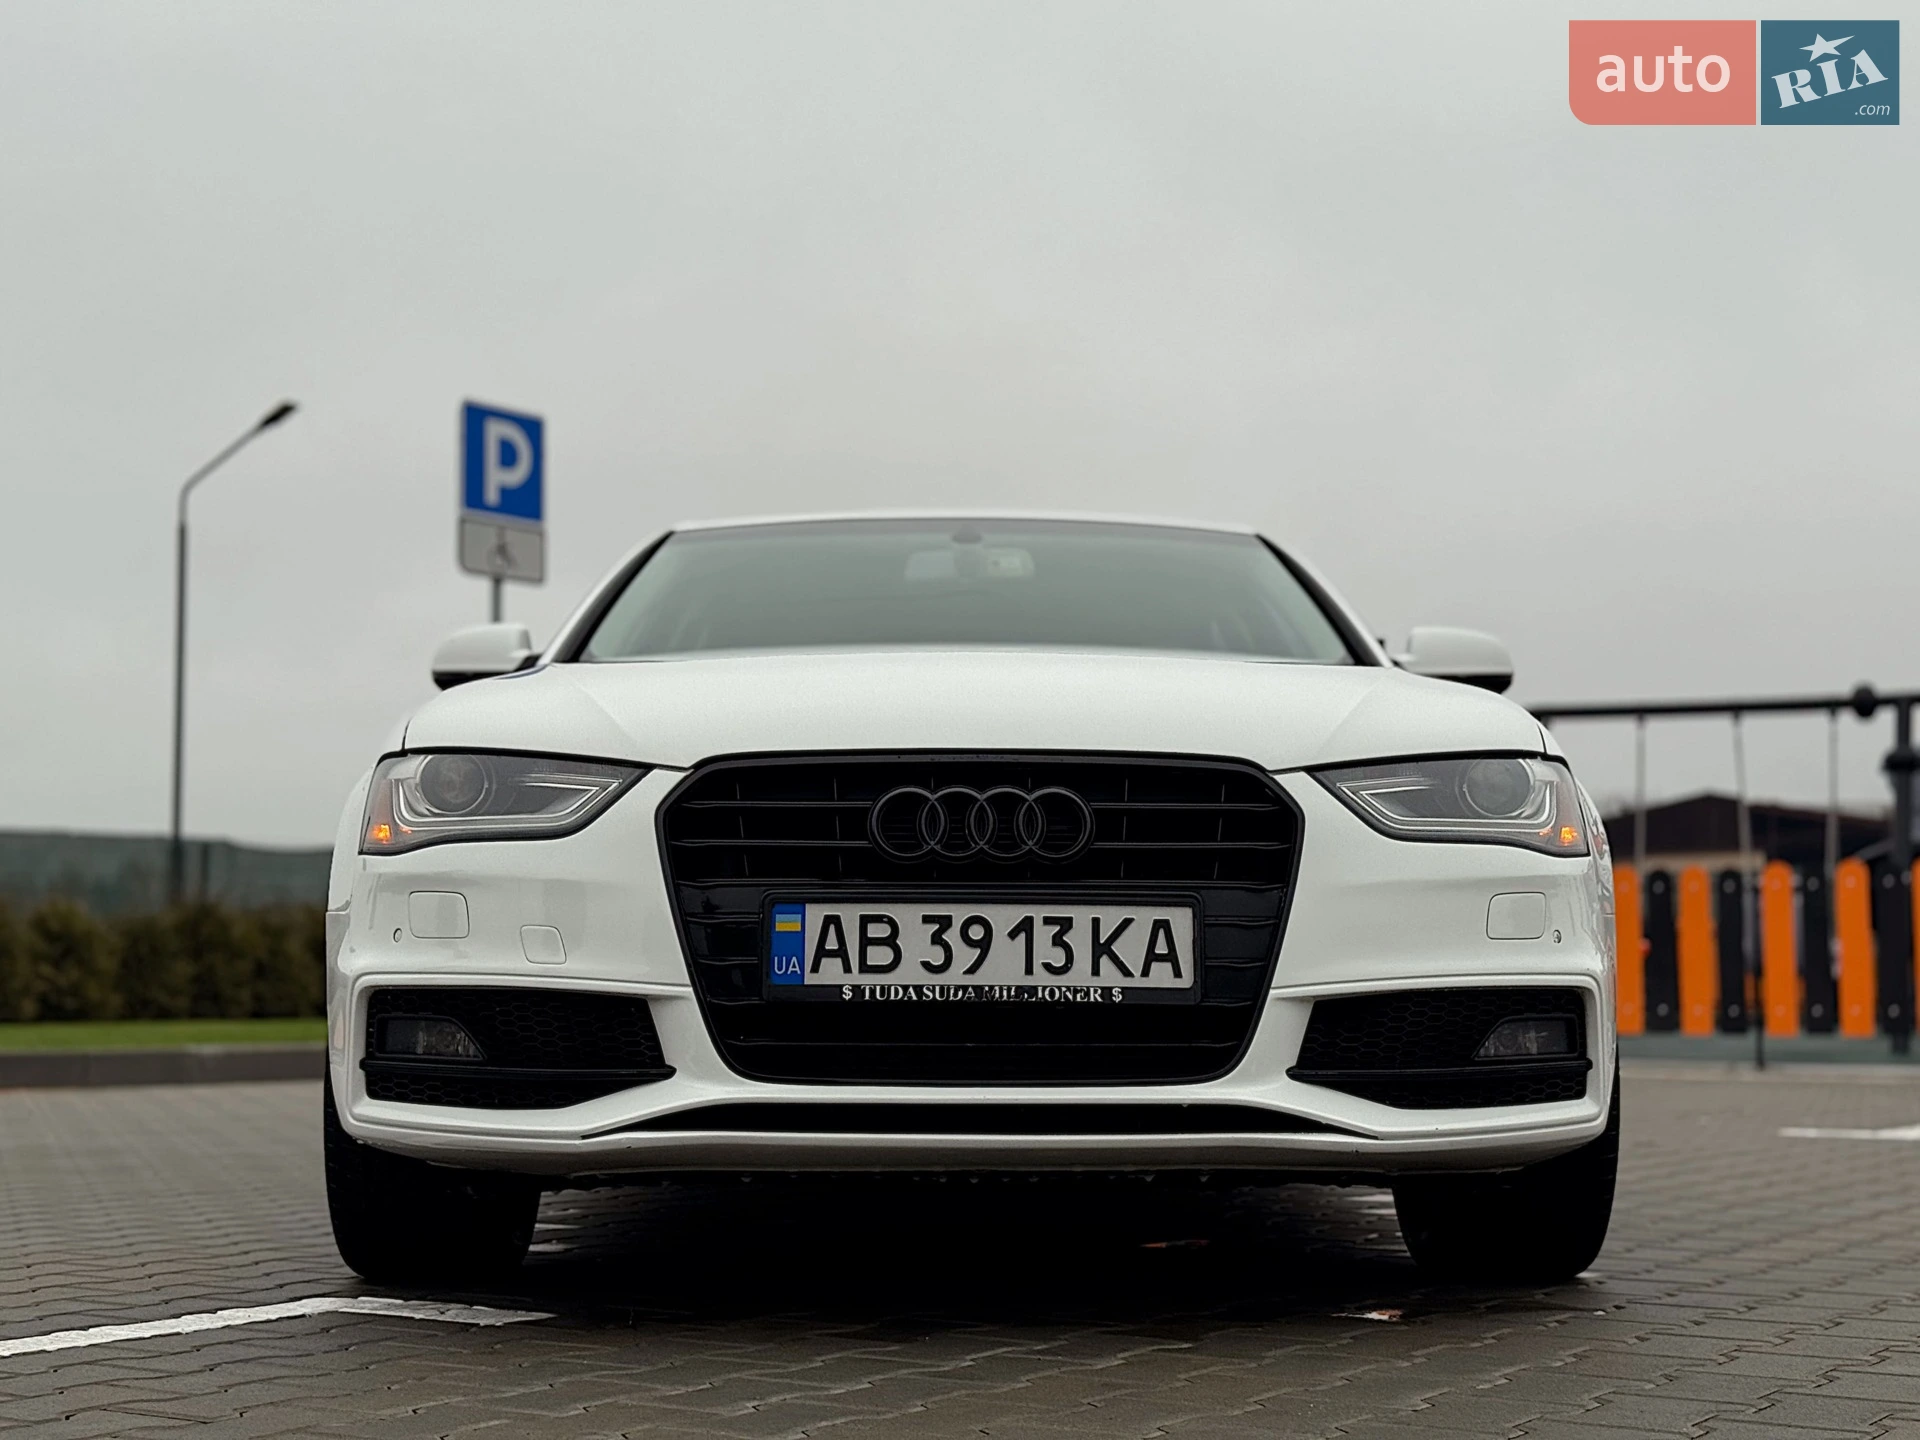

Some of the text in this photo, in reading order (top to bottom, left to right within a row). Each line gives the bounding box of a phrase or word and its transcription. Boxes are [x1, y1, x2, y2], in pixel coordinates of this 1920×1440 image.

[482, 414, 535, 508] P
[774, 956, 801, 975] UA
[809, 913, 902, 974] AB
[1091, 916, 1183, 979] KA
[860, 985, 918, 1001] TUDA
[922, 985, 976, 1001] SUDA
